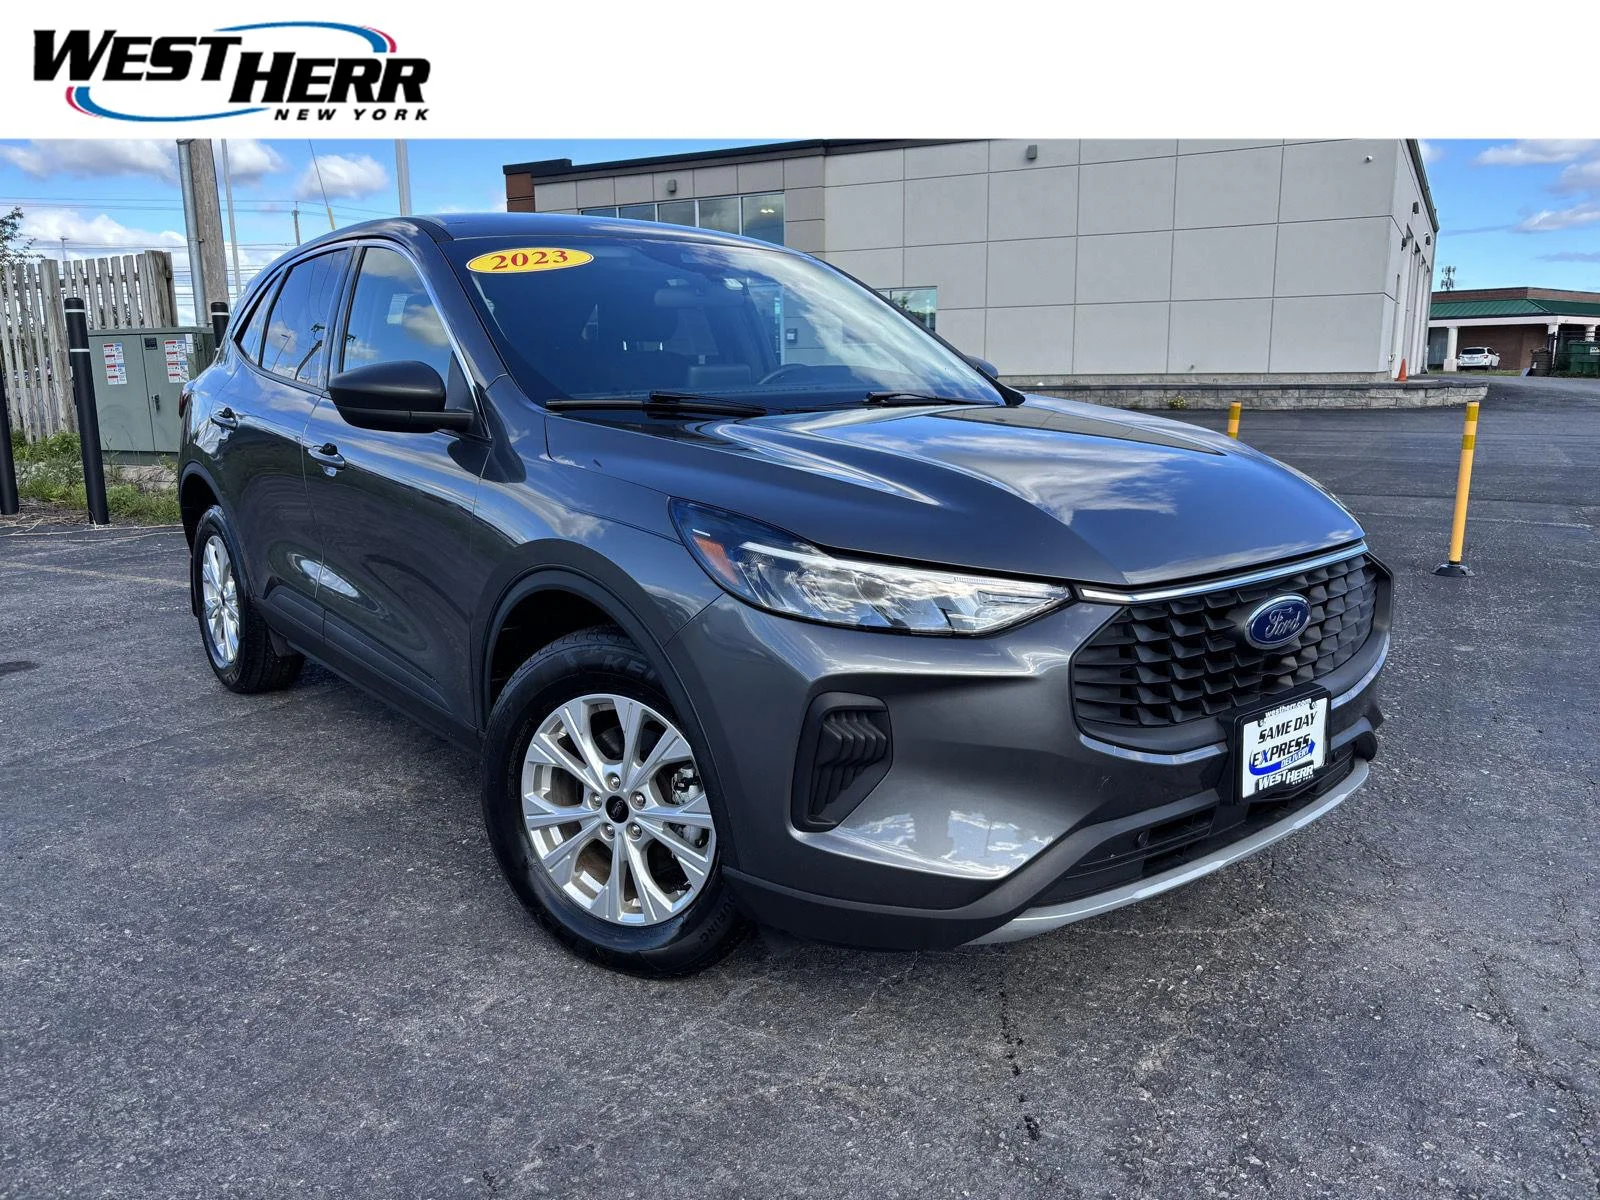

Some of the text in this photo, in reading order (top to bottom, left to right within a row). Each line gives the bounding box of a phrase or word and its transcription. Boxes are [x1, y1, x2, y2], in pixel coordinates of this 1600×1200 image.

[490, 250, 569, 270] 2023
[1265, 606, 1300, 638] Ford
[1257, 710, 1318, 744] SAME DAY
[1252, 733, 1310, 768] EXPRESS
[1258, 769, 1289, 791] WEST
[1285, 765, 1314, 785] HERR
